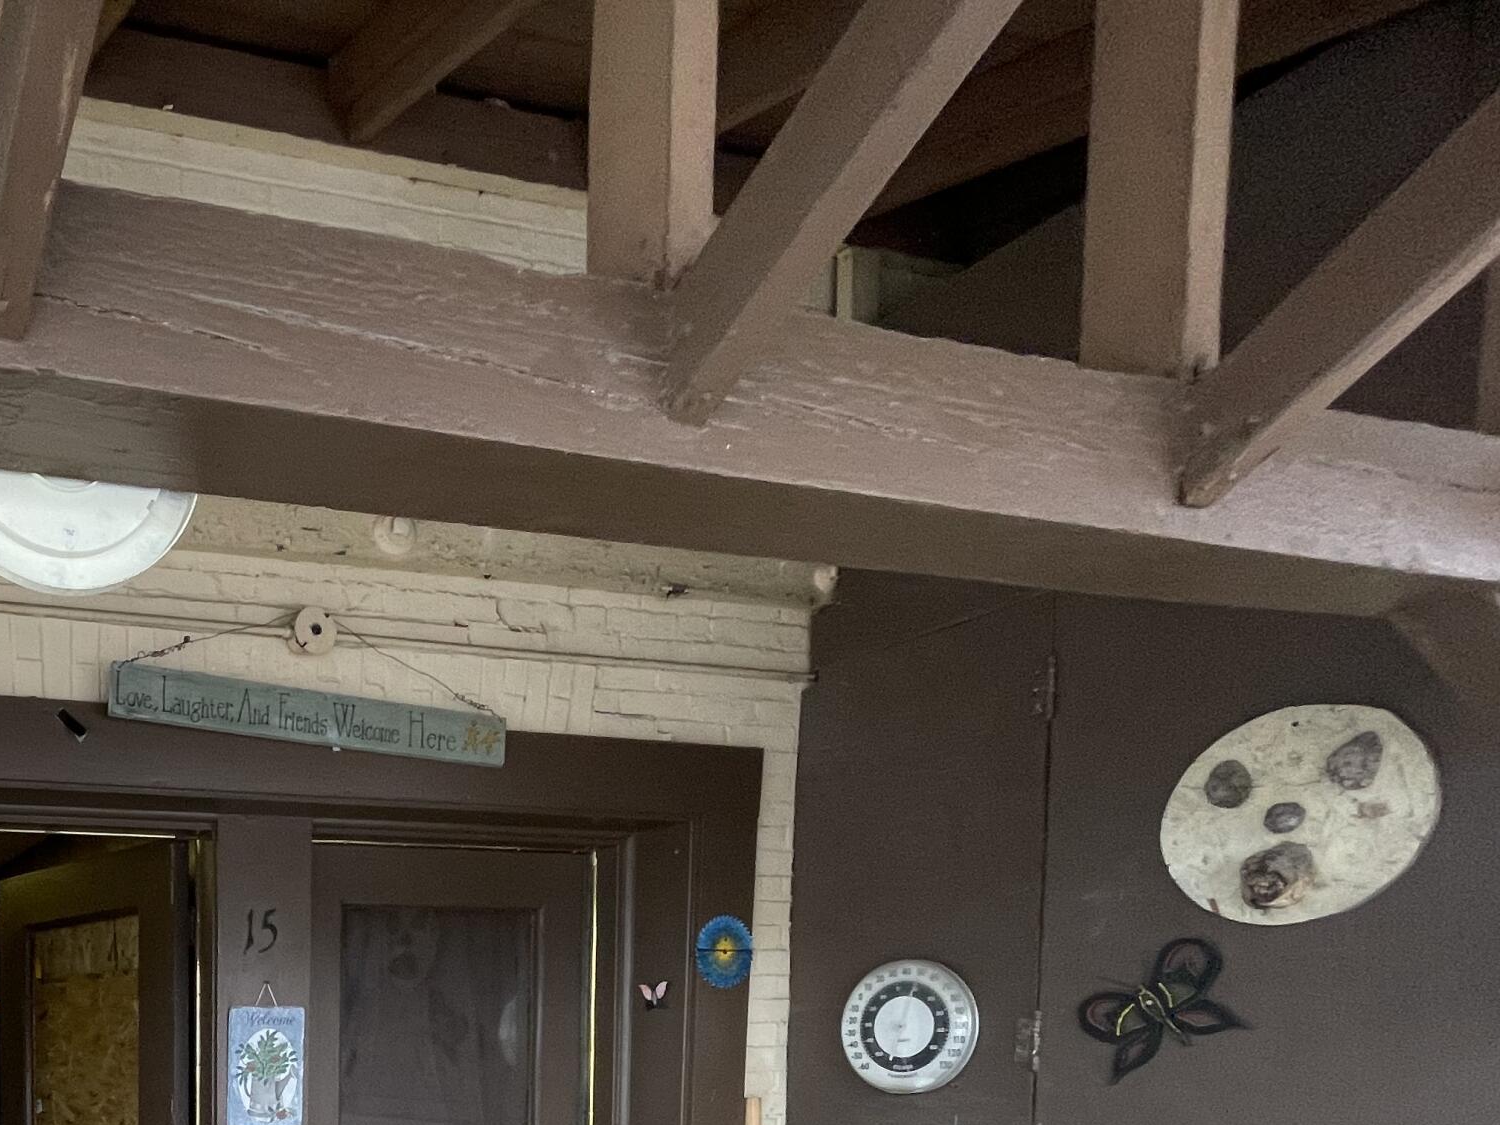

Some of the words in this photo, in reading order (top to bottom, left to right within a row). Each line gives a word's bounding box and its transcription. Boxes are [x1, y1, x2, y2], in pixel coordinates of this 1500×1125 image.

[115, 670, 159, 713] Love,
[162, 675, 234, 723] Laughter,
[237, 688, 270, 726] And
[277, 692, 328, 736] Friends
[332, 702, 400, 744] Welcome
[407, 710, 457, 751] Here
[243, 908, 278, 955] 15
[244, 1010, 296, 1027] Welcome
